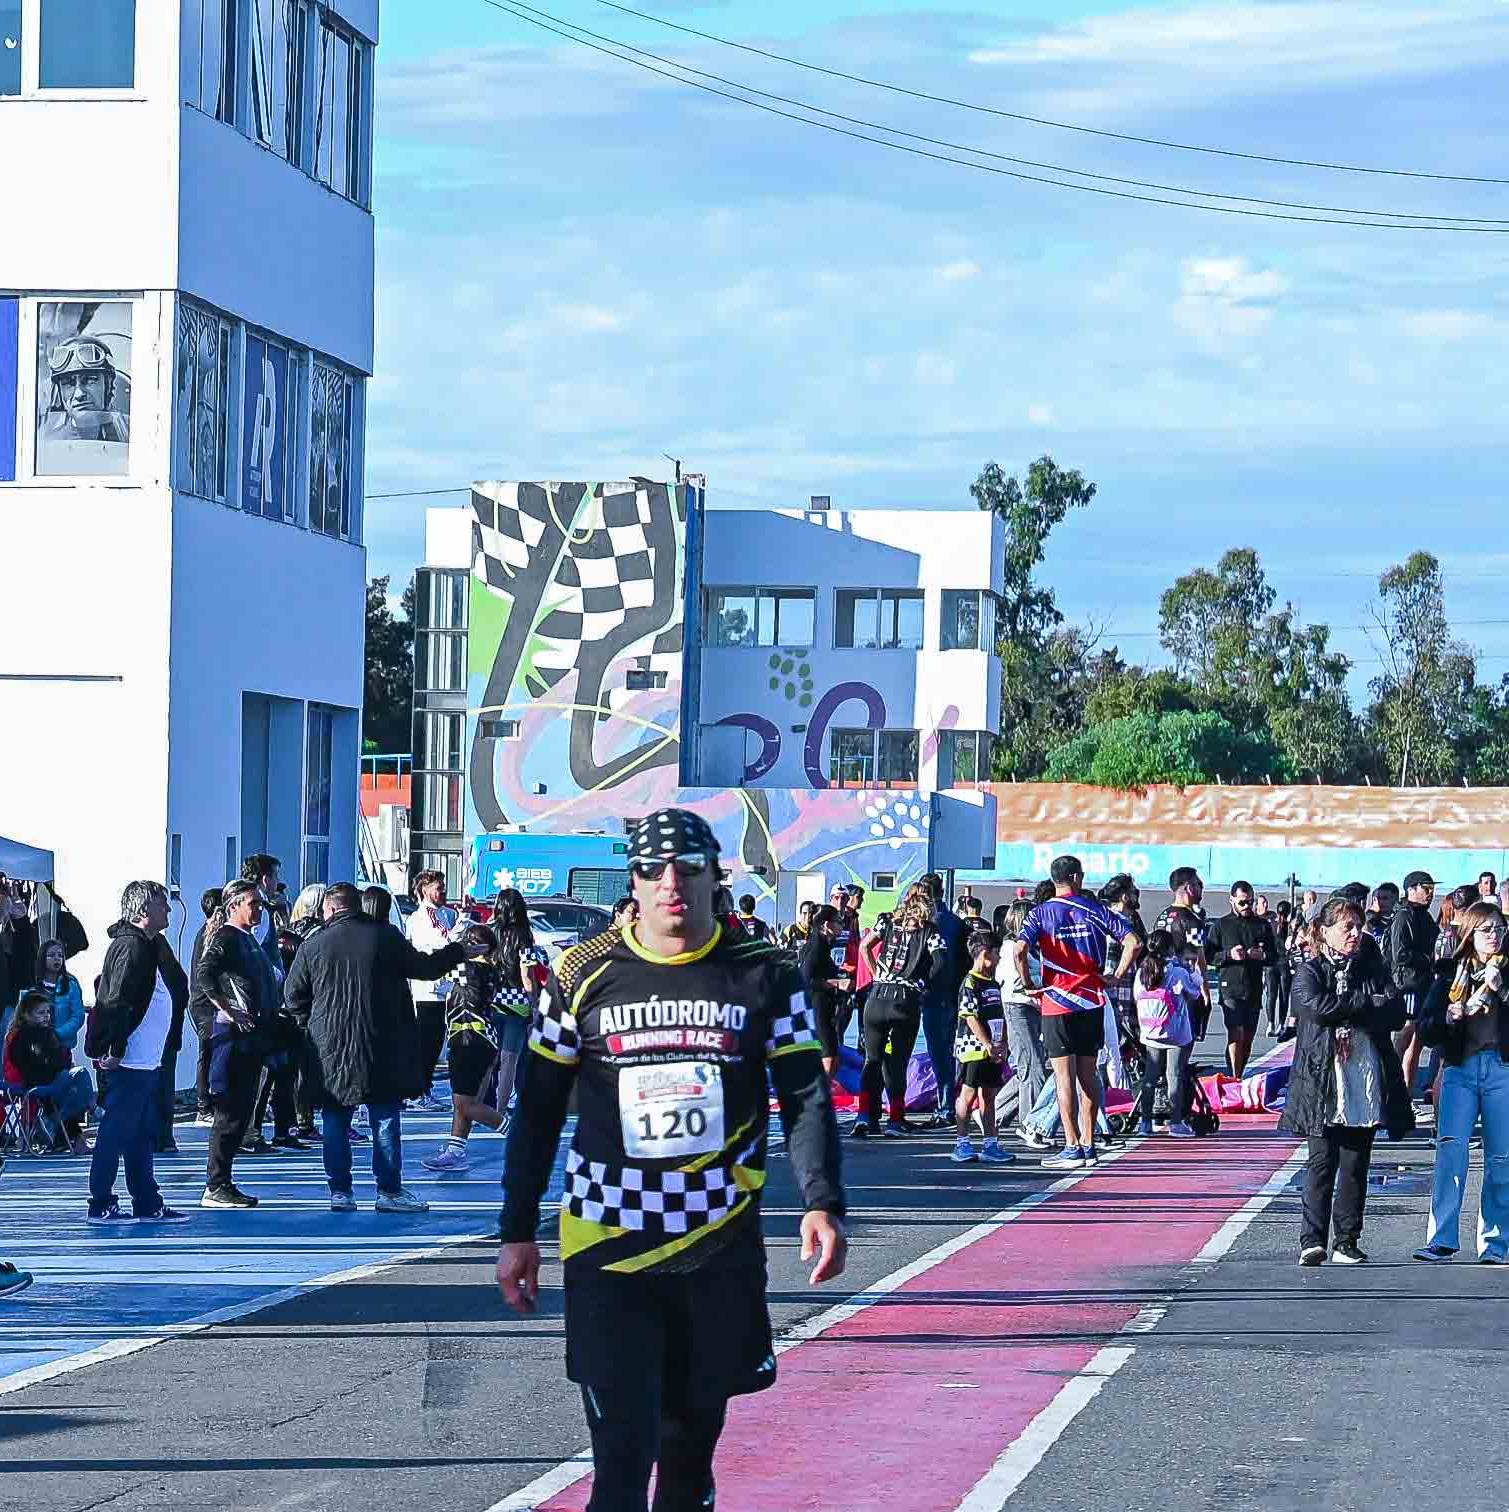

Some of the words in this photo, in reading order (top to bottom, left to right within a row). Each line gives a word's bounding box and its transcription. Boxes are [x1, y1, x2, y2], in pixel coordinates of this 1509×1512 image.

[1033, 844, 1150, 873] Rario
[517, 880, 552, 893] 107
[599, 995, 747, 1036] AUTÓDROMO
[621, 1030, 683, 1052] RUNNING
[685, 1030, 723, 1049] RACE
[638, 1108, 708, 1141] 120
